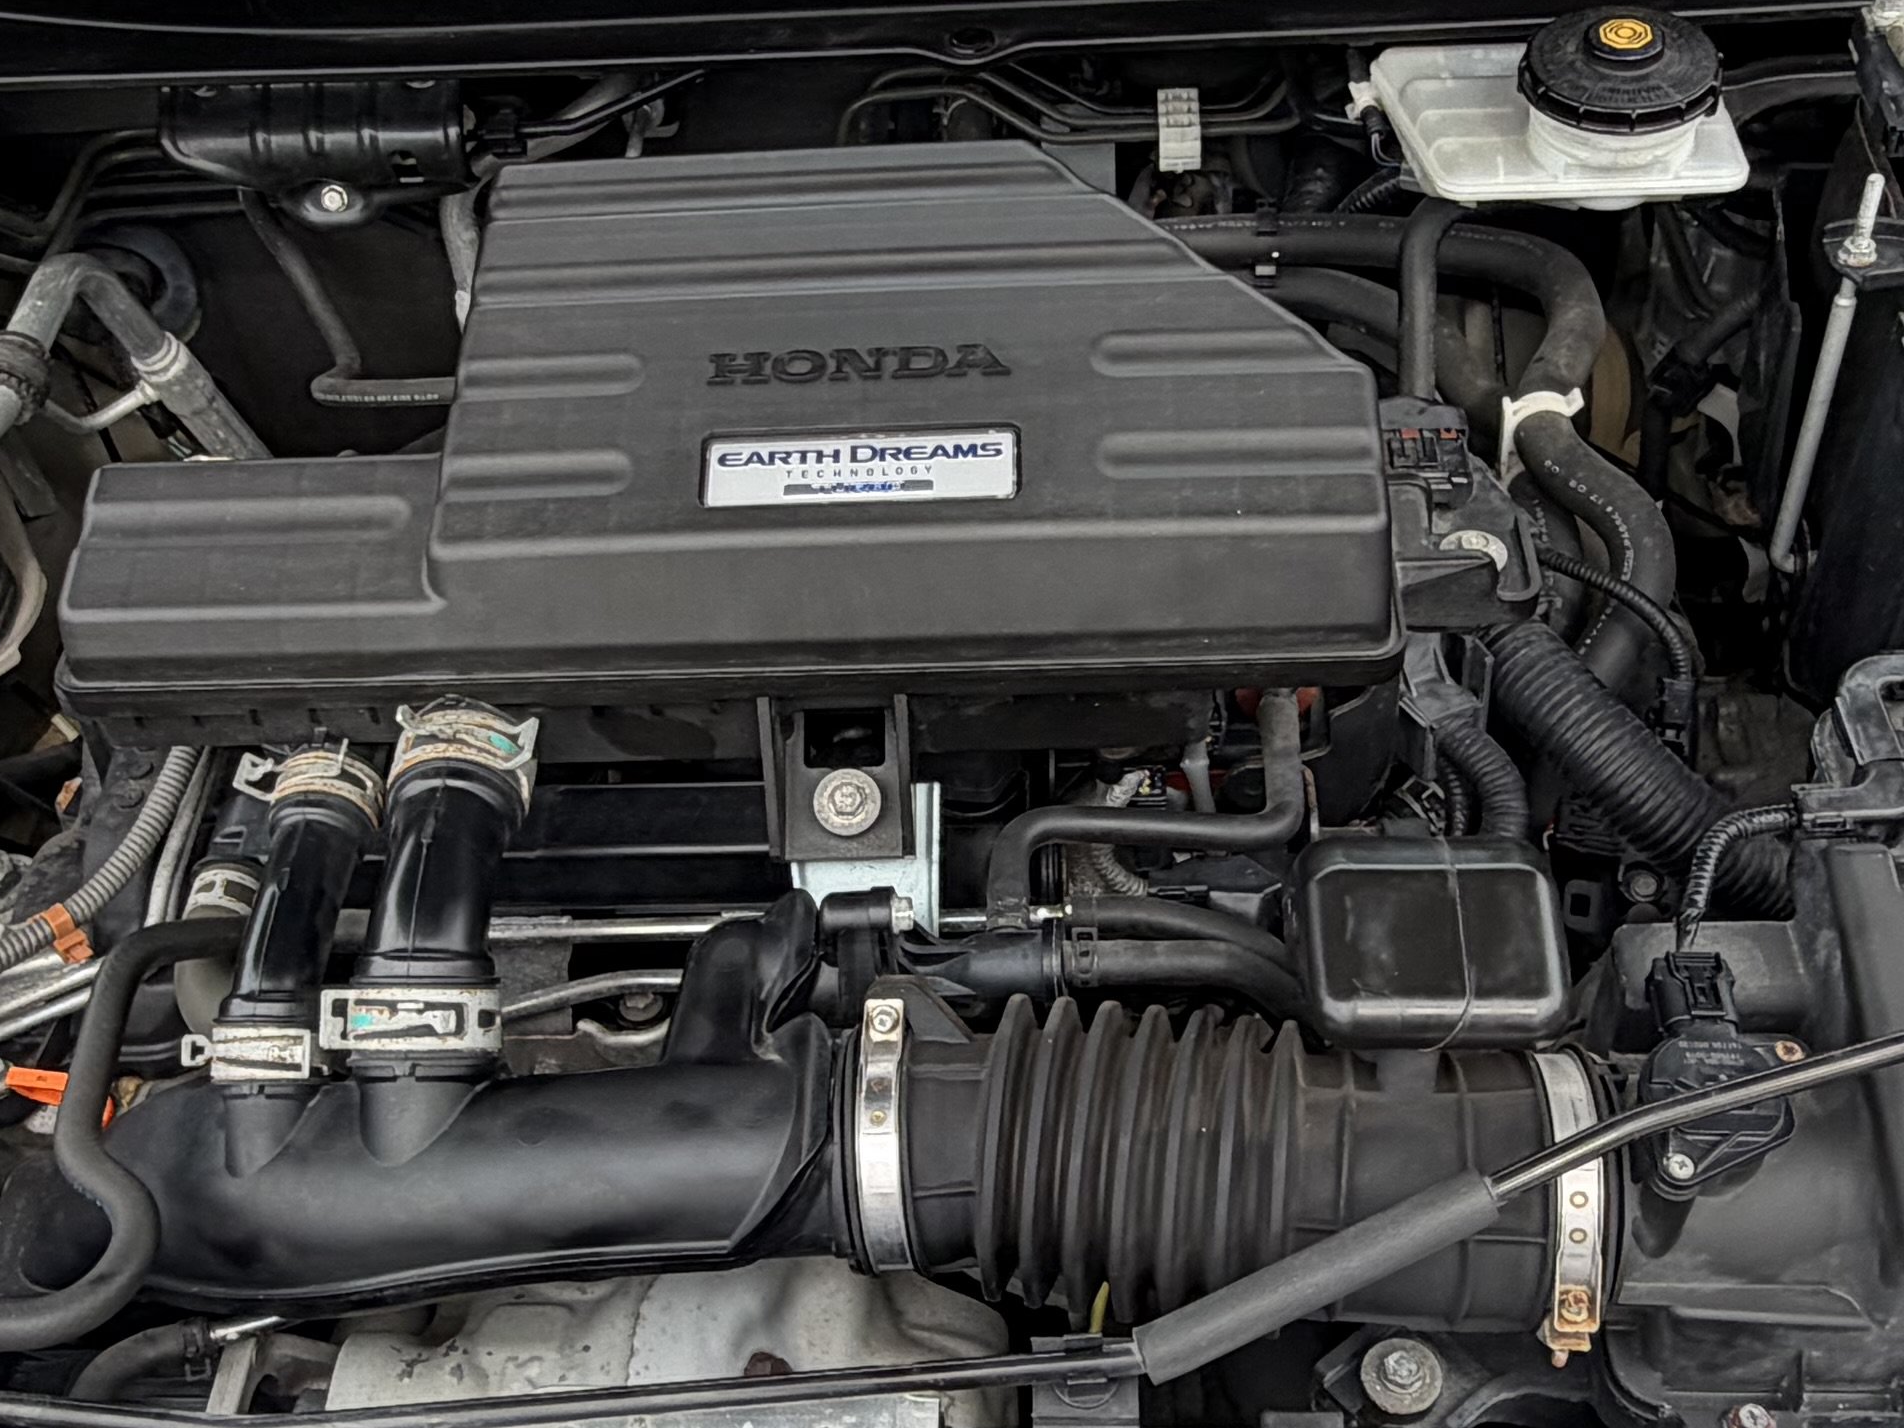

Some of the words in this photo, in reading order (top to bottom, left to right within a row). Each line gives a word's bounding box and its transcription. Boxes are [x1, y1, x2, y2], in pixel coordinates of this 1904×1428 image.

[706, 343, 1012, 386] HONDA
[717, 448, 841, 468] EARTH
[849, 441, 1003, 464] DREAMS
[784, 465, 934, 479] TECHNOLOGY
